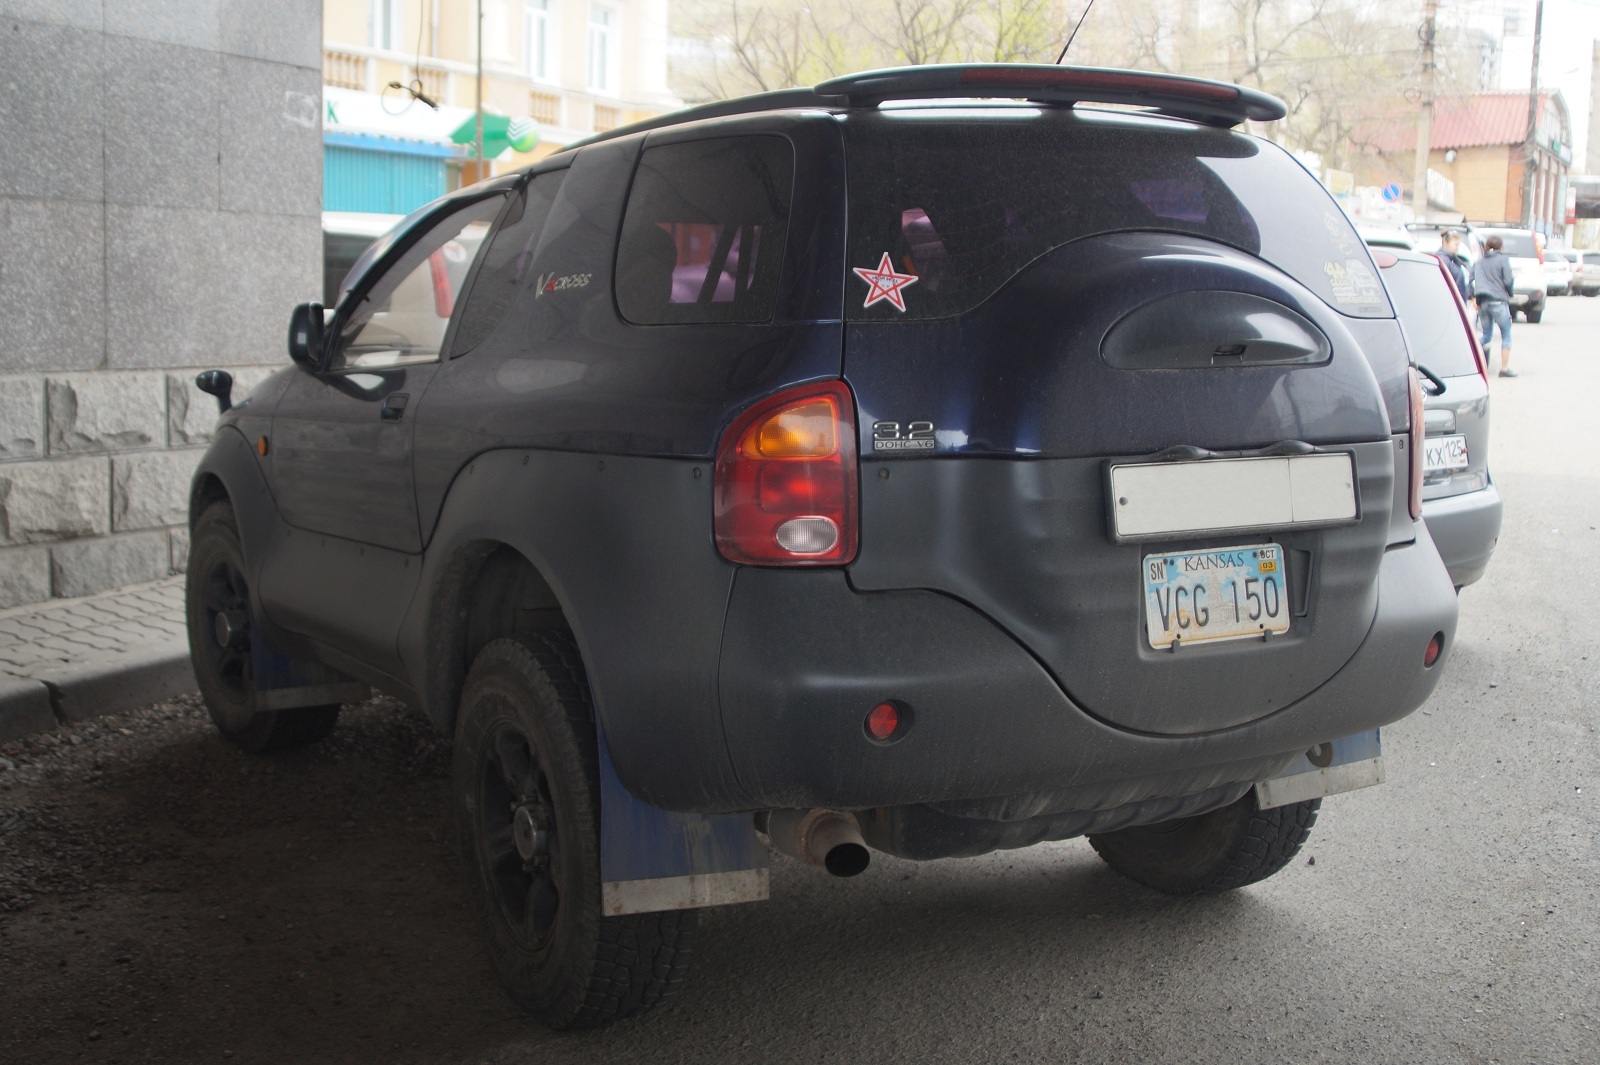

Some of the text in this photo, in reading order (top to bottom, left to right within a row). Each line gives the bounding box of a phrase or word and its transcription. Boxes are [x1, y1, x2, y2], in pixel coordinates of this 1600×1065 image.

[873, 420, 934, 440] 3.2
[875, 440, 934, 449] DOHC V6
[1150, 562, 1165, 581] SN
[1184, 552, 1245, 572] KANSAS
[1262, 561, 1274, 569] 03
[1156, 576, 1279, 632] VCG 150
